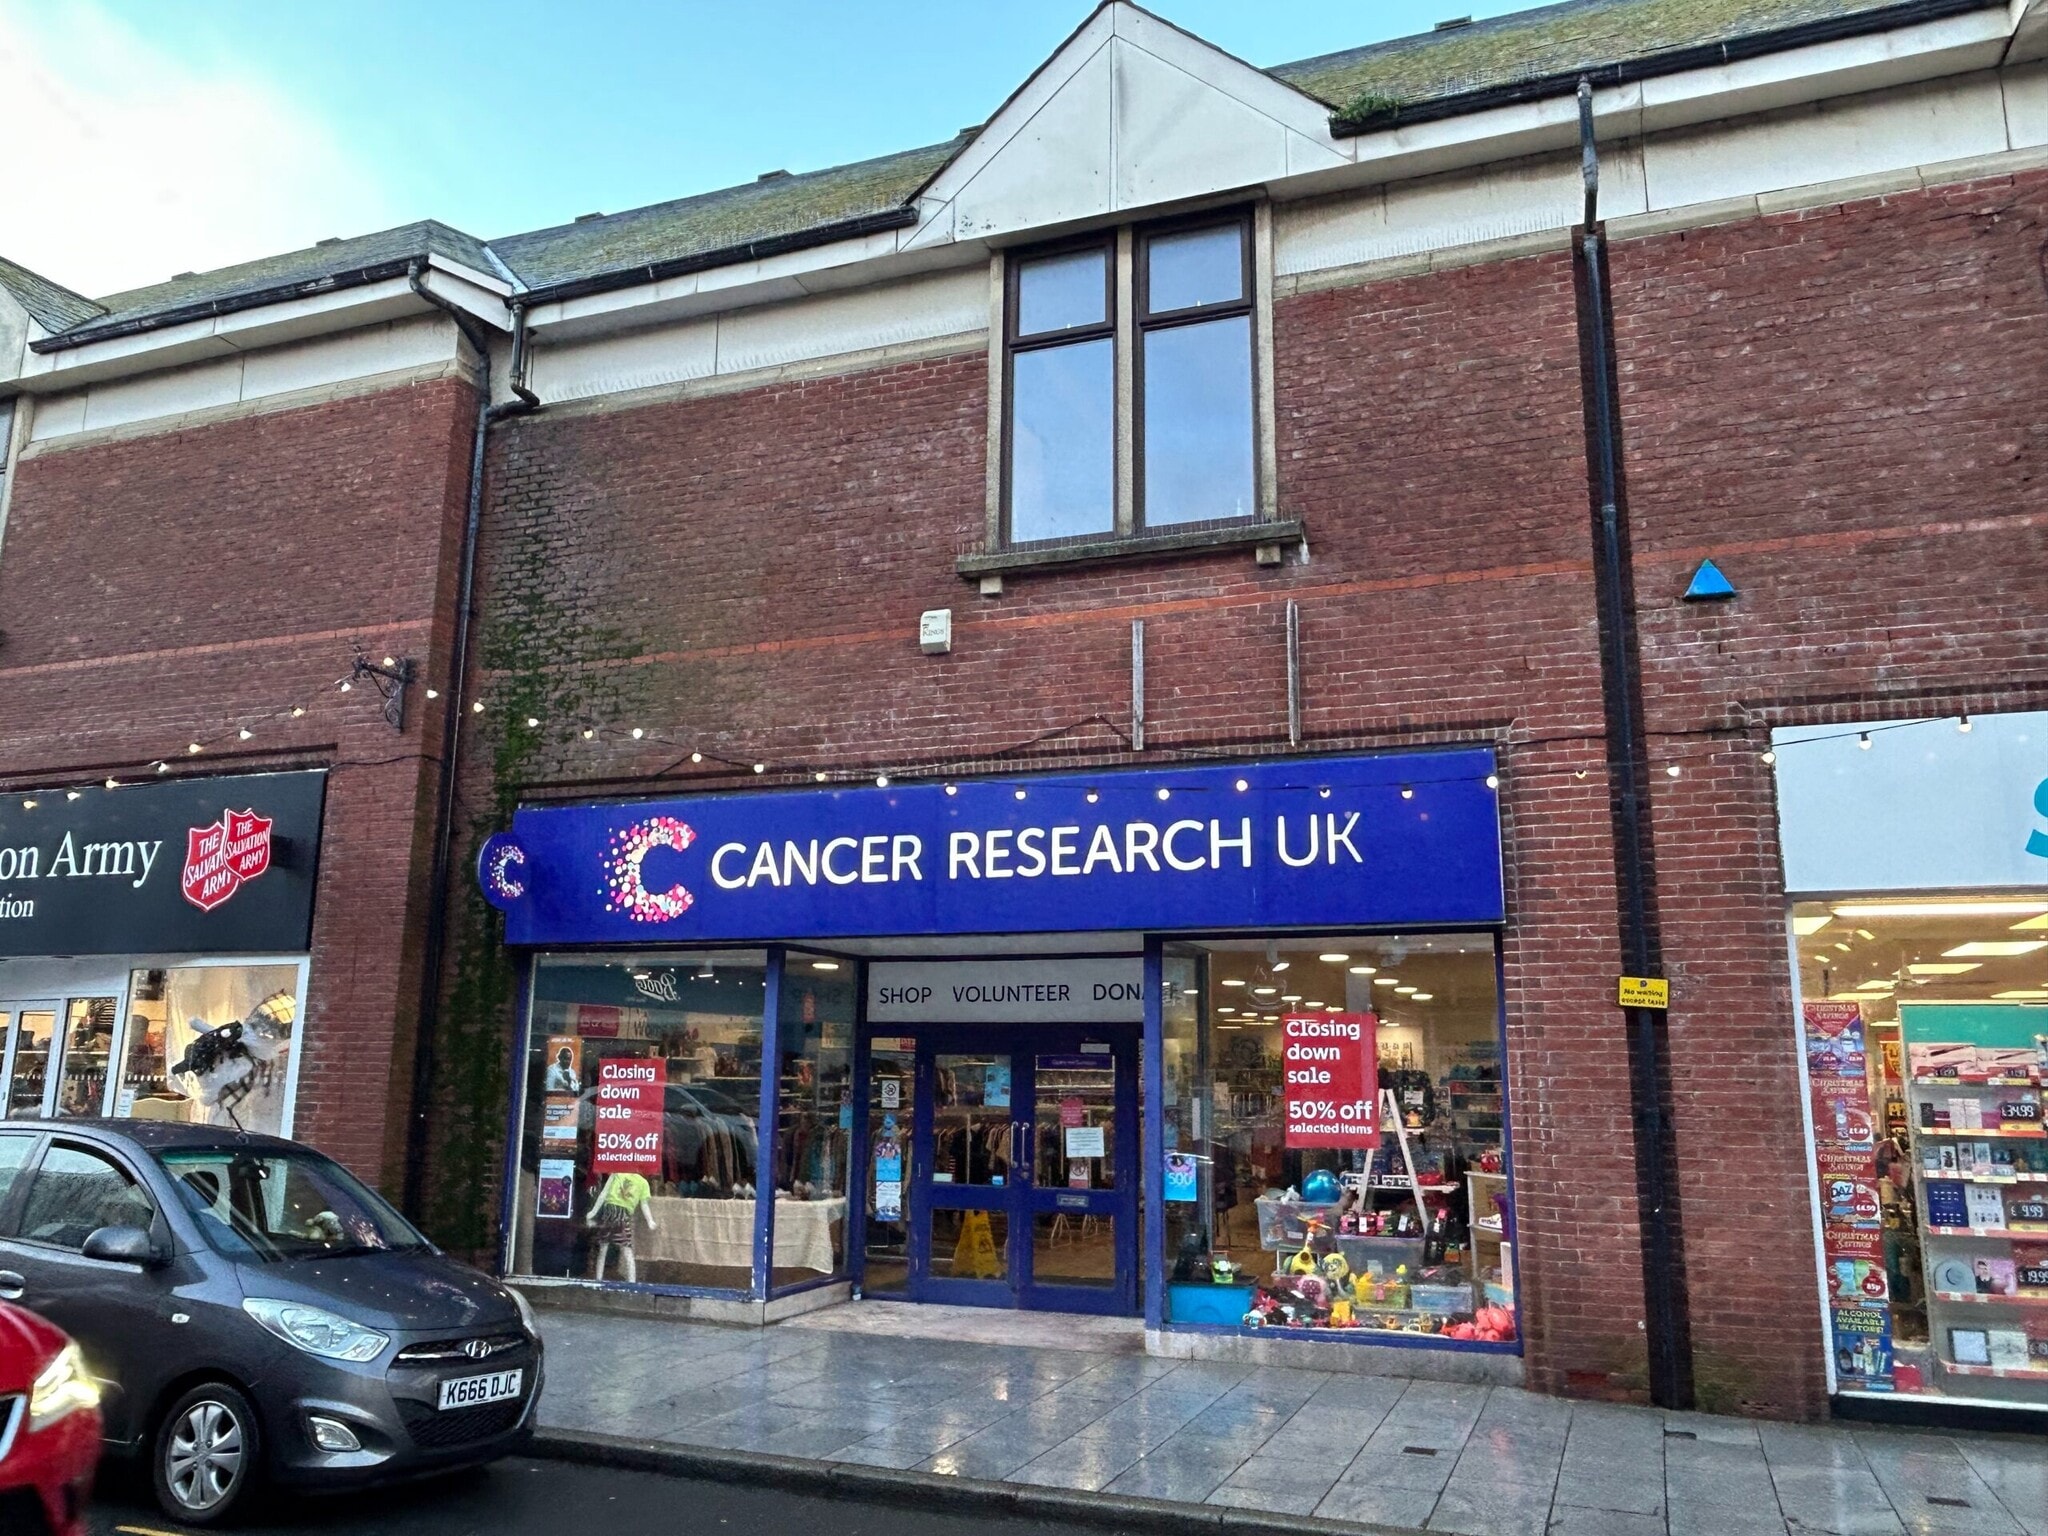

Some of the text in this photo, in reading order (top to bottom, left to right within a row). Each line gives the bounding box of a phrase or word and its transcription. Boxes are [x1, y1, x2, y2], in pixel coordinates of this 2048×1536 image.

[235, 819, 253, 838] THE
[199, 832, 220, 858] THE
[226, 827, 269, 860] SALVATION
[711, 811, 1363, 889] CANCER RESEARCH UK
[47, 830, 163, 888] Army
[239, 846, 265, 872] ARMY
[186, 851, 225, 888] SALVAT
[879, 983, 1144, 1004] SHOP VOLUNTEER DON
[1286, 1020, 1361, 1041] Closing
[1286, 1043, 1341, 1060] down
[602, 1064, 656, 1082] Closing
[1287, 1066, 1332, 1084] sale
[600, 1084, 640, 1099] down
[599, 1104, 632, 1119] sale
[1289, 1100, 1373, 1120] 50% off
[2001, 1104, 2035, 1118] £34.99
[1289, 1122, 1373, 1135] selected items
[598, 1132, 659, 1150] 50% off
[597, 1152, 657, 1163] selected items
[446, 1373, 517, 1405] K666 DJC
